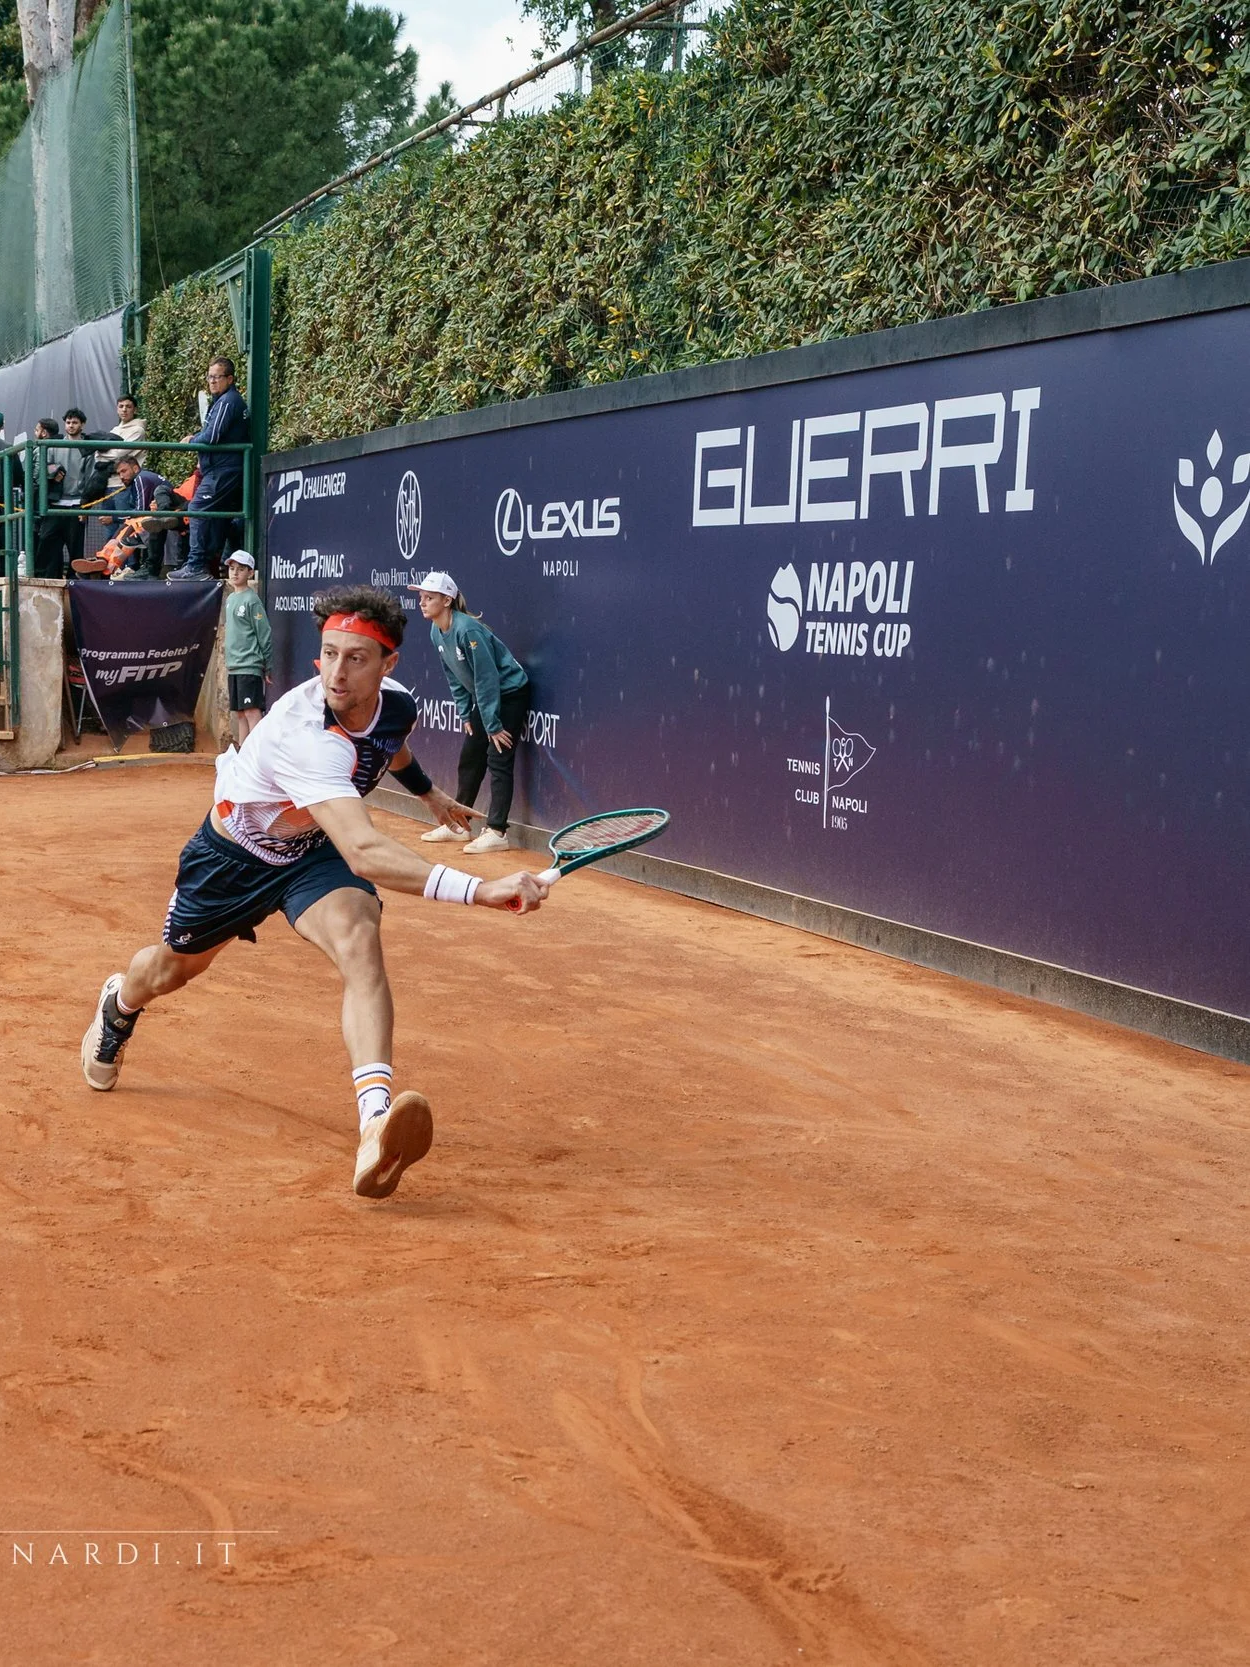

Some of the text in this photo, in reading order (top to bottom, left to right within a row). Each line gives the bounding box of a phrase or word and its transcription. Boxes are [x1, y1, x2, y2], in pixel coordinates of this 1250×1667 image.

[692, 387, 1041, 526] GUERRI
[272, 470, 346, 514] ATP CHALLENGER
[527, 497, 620, 539] LEXUS
[271, 549, 344, 579] Nitto ATP FINALS
[543, 560, 579, 576] NAPOLI
[371, 568, 390, 586] GRAND
[391, 568, 408, 586] HOTEL
[806, 560, 914, 614] NAPOLI
[274, 596, 305, 611] ACQUISTA
[805, 621, 911, 658] TENNIS CUP
[81, 646, 188, 660] Programma Fedeltà
[95, 661, 182, 686] myFITP
[787, 758, 821, 775] TENNIS
[795, 788, 819, 805] CLUB
[832, 796, 868, 814] NAPOLI
[831, 814, 848, 831] 1905
